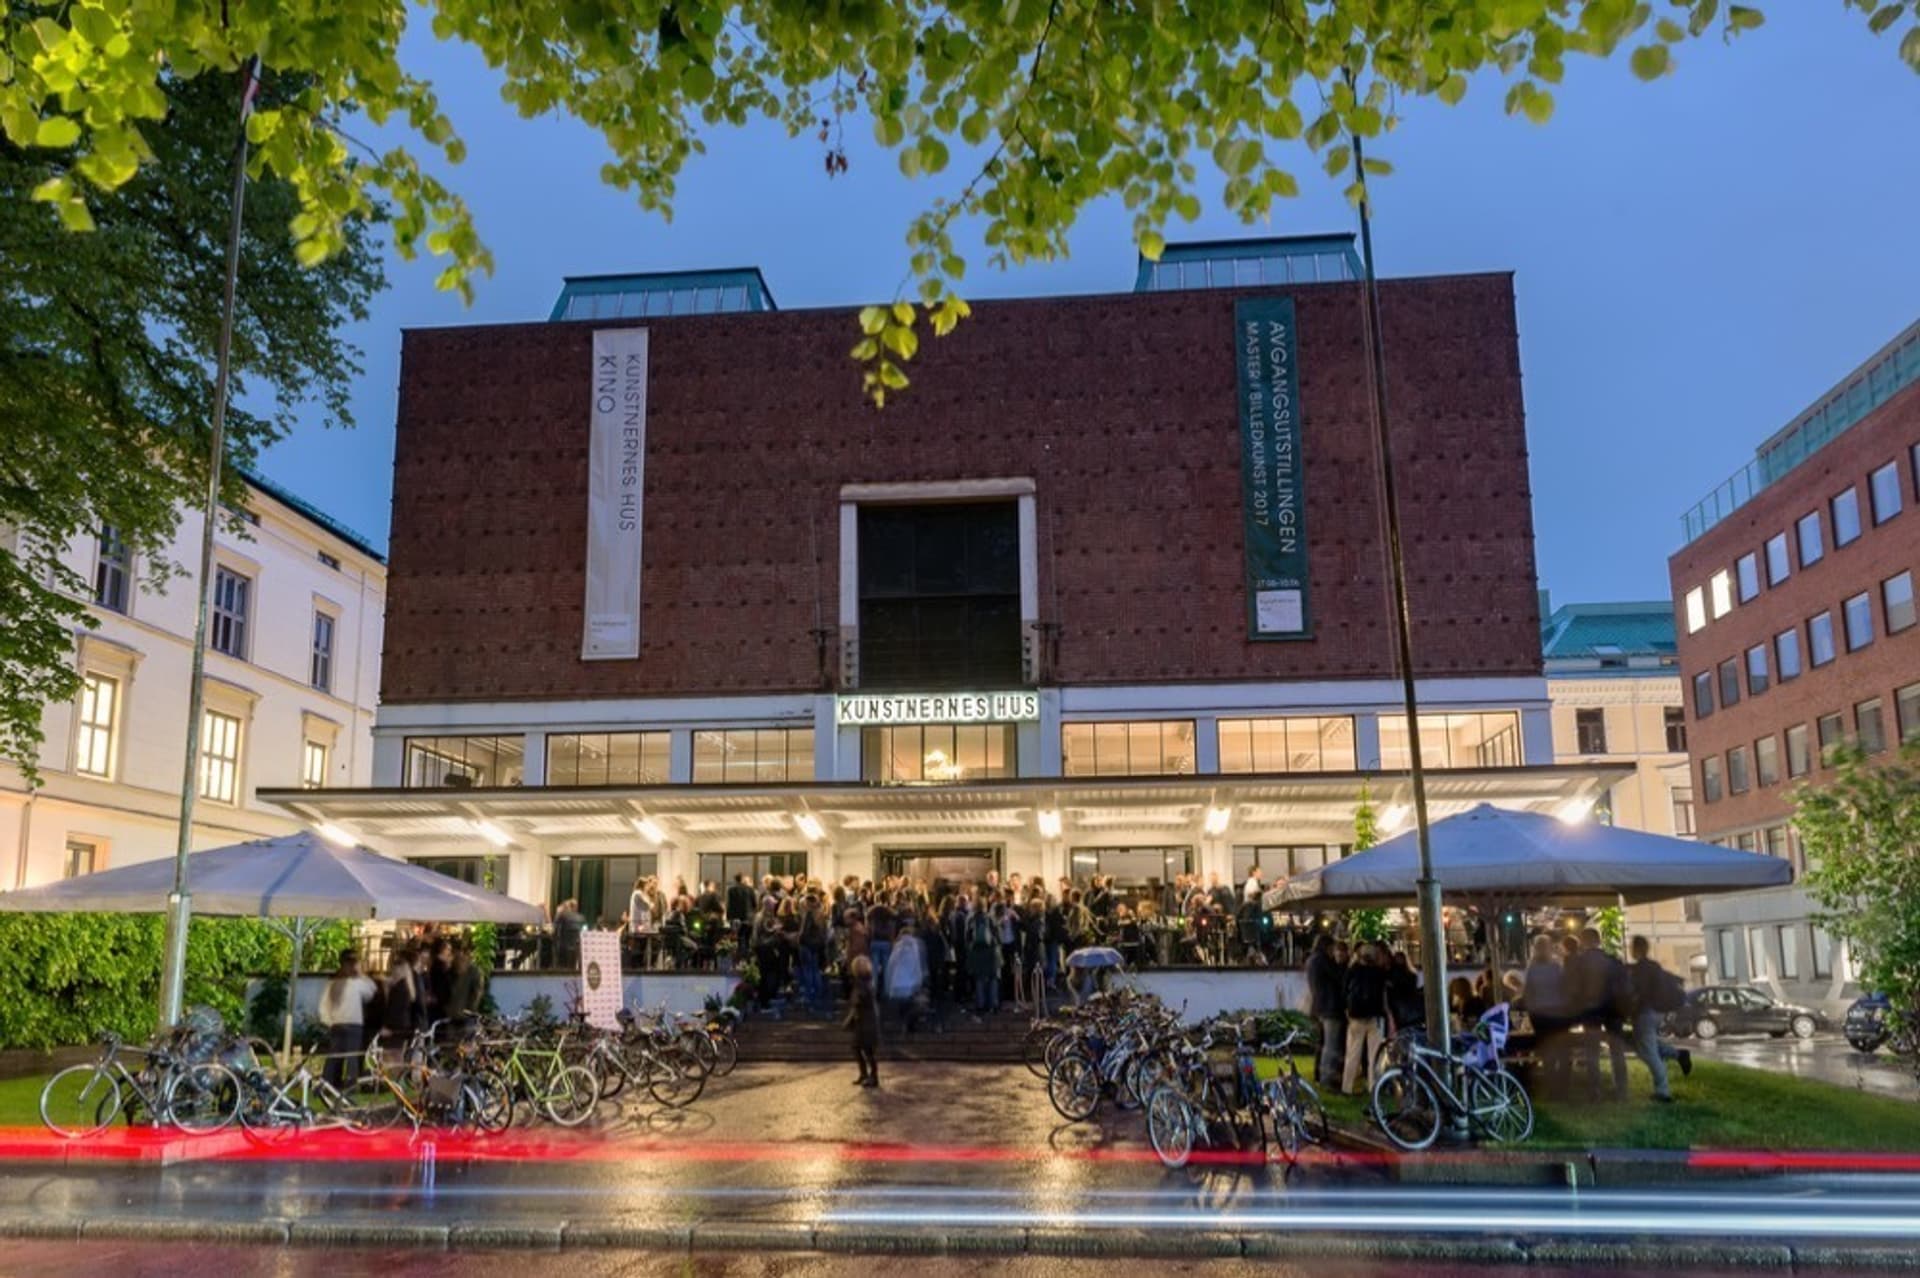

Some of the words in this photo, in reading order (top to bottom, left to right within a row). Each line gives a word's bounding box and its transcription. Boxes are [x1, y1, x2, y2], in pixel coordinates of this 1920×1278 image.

[1246, 321, 1261, 379] MASTER
[597, 355, 617, 415] KINO
[622, 353, 641, 486] KUNSTNERNES
[1249, 392, 1267, 486] BILLEDKUNST
[1268, 320, 1297, 554] AVGANGSUTSTILLINGEN
[619, 493, 636, 531] HUS
[1253, 491, 1269, 526] 2017
[840, 697, 987, 720] KUNSTNERNES
[996, 695, 1036, 716] HUS
